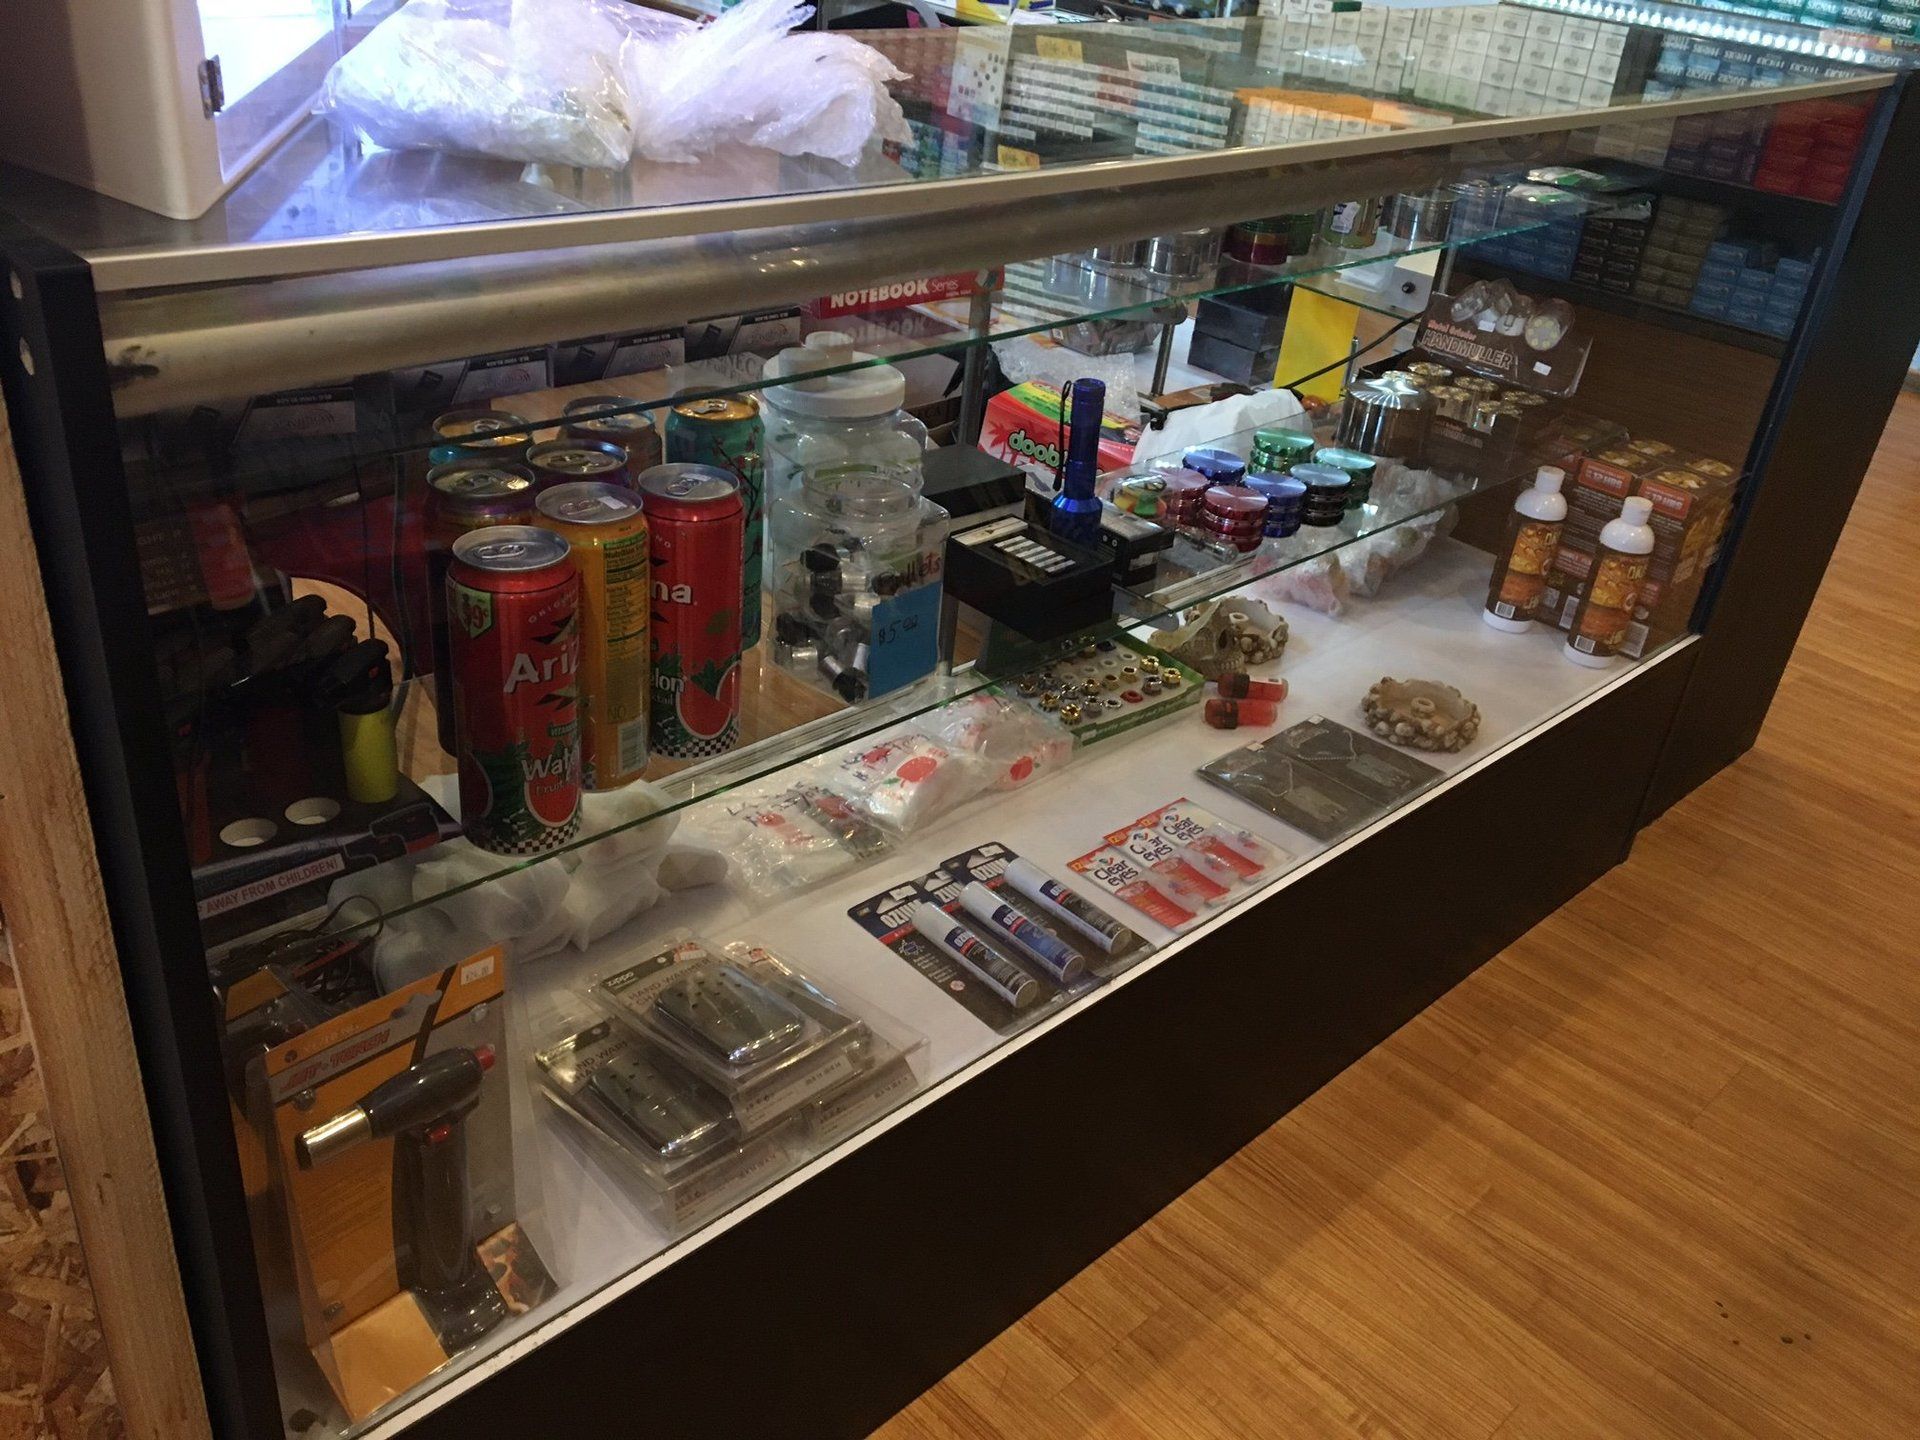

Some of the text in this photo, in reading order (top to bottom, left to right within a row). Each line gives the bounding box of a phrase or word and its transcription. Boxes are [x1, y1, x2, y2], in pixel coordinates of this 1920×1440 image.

[1842, 6, 1873, 21] SIGNAL
[1880, 14, 1912, 29] SIGNAL
[830, 279, 929, 309] NOTEBOOK
[931, 279, 958, 293] Series
[1421, 329, 1513, 370] HANDMULLER
[1007, 428, 1059, 466] doob
[1163, 817, 1194, 835] Clear
[1177, 825, 1204, 841] eyes
[1143, 844, 1173, 861] eyes
[1093, 859, 1129, 880] Clear
[1107, 868, 1139, 887] eyes
[206, 857, 338, 914] AWAY FROM CHILDREN!
